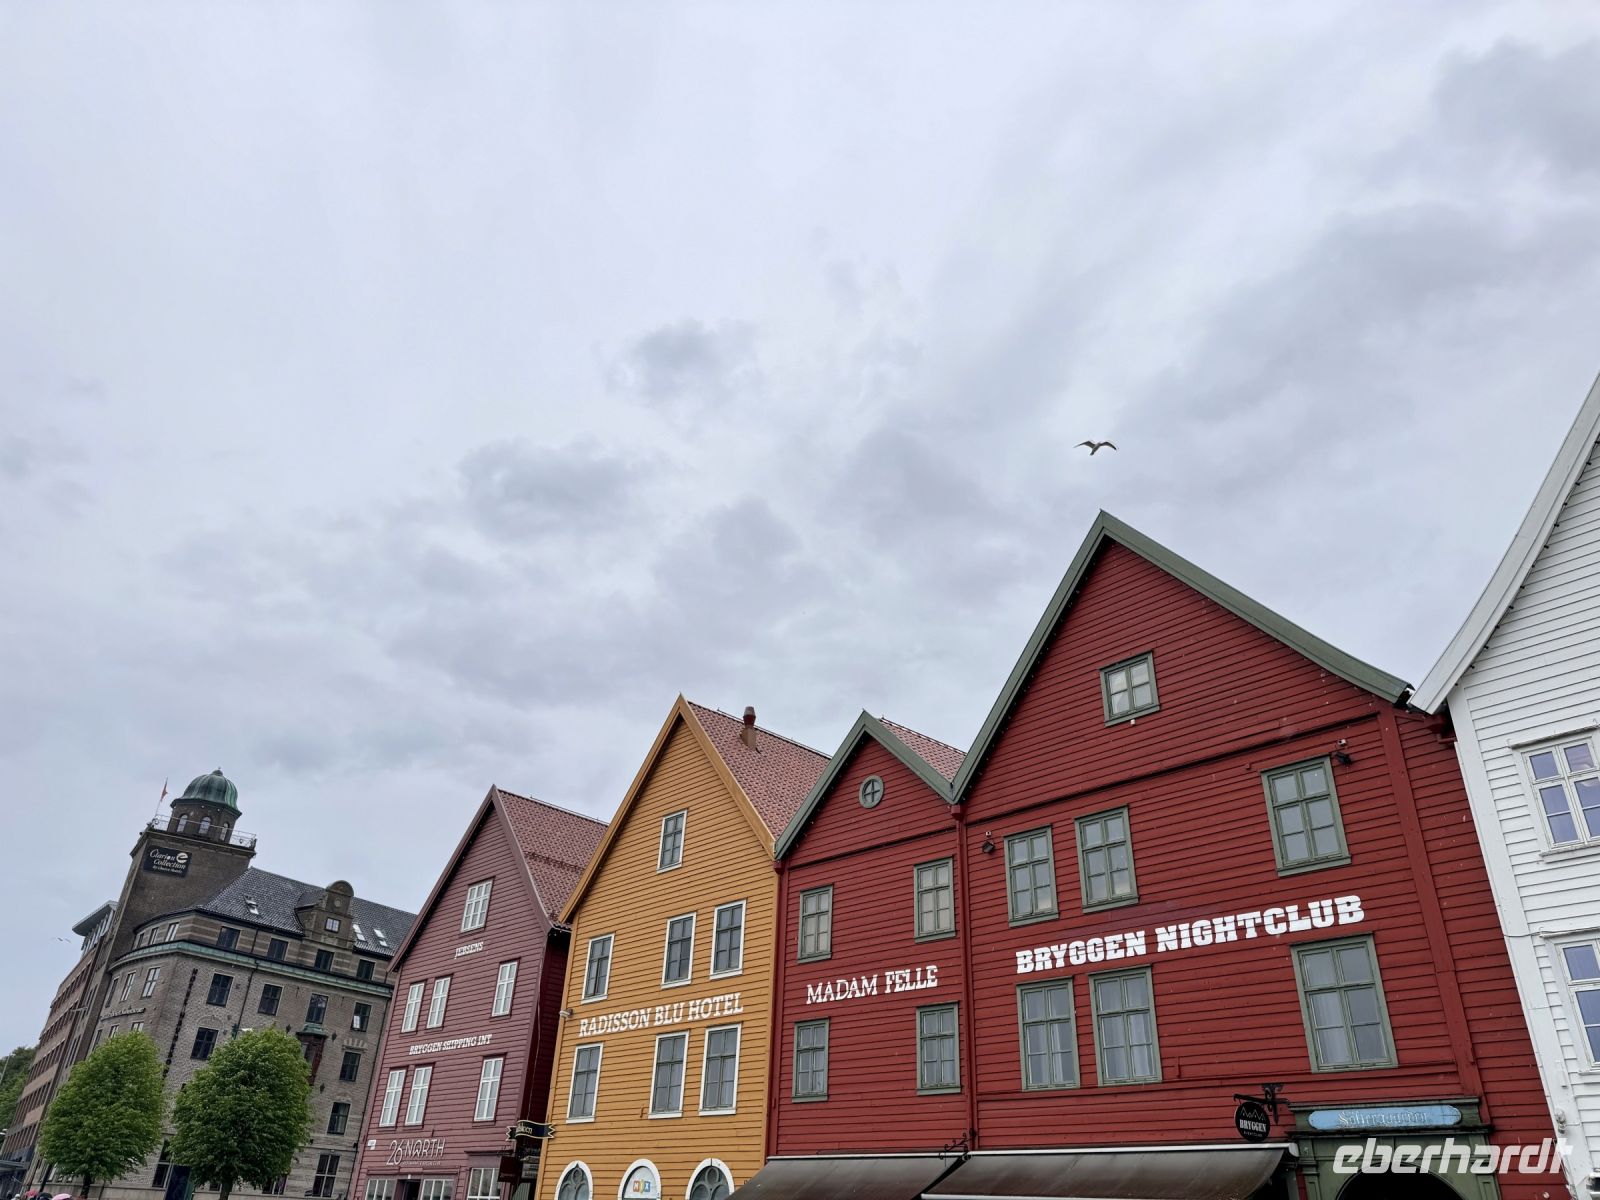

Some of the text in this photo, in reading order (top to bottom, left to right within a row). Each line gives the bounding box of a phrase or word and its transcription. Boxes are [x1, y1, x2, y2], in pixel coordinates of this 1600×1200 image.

[150, 849, 176, 861] Clarion
[153, 859, 186, 870] Collection
[1016, 895, 1365, 974] BRYGGEN NIGHTCLUB
[806, 965, 938, 1004] MADAM FELLE
[579, 992, 744, 1037] RADISSON BLU HOTEL
[409, 1042, 443, 1055] BRYGGEN
[442, 1036, 477, 1051] SHIPPING
[1239, 1119, 1267, 1132] BRYGGEN
[386, 1138, 446, 1166] 26 NORTH
